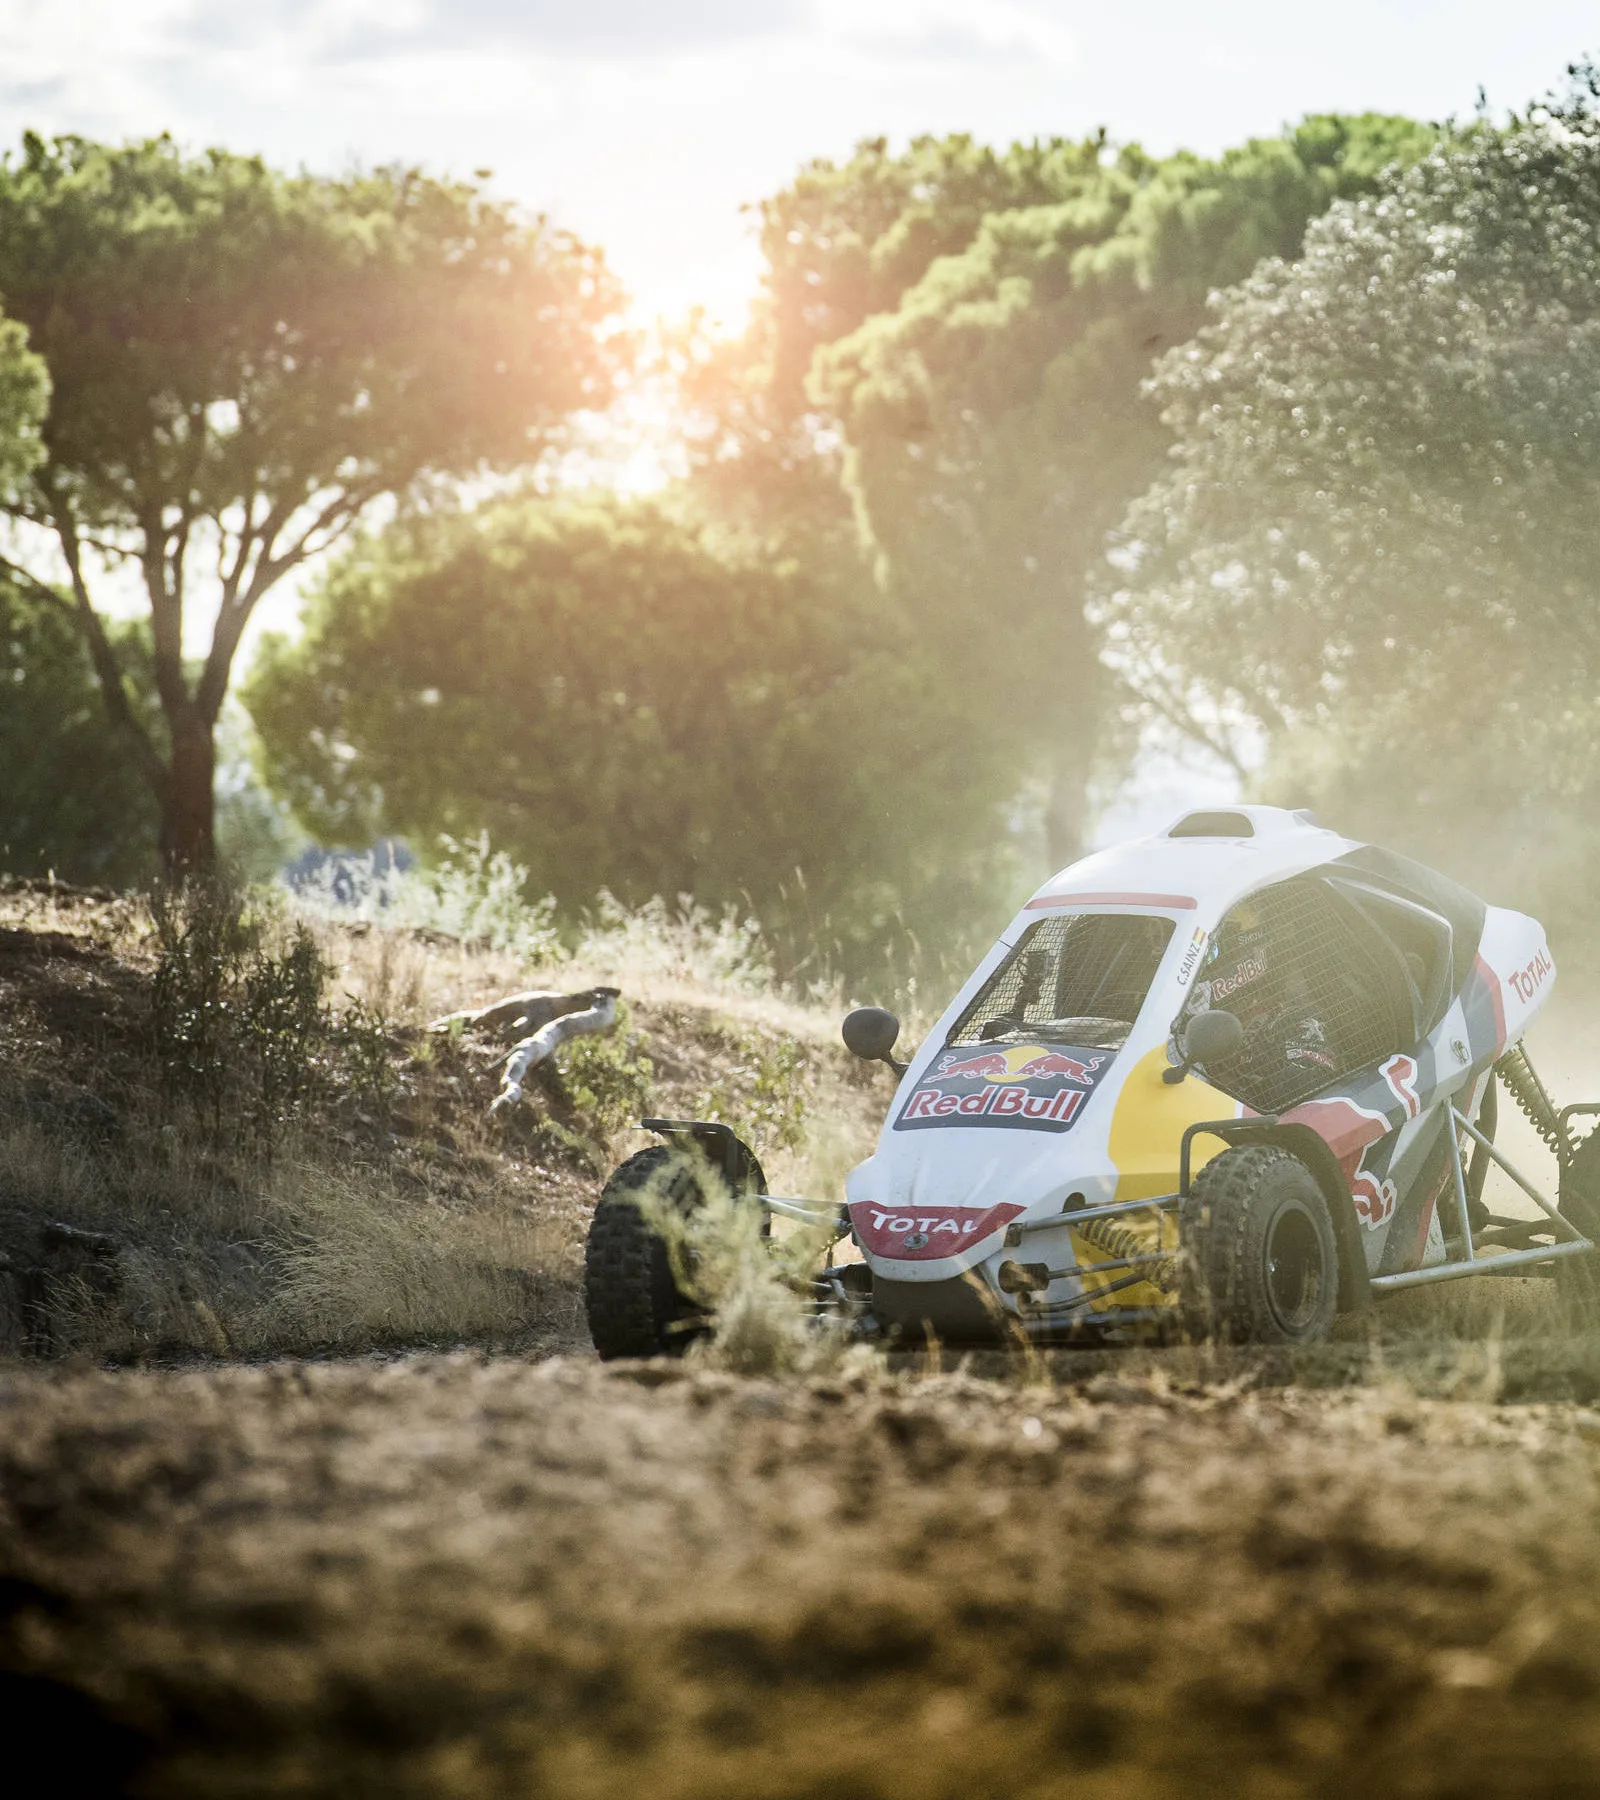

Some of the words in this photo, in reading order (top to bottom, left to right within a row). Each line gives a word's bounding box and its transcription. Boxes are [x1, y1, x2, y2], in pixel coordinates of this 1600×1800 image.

[1211, 962, 1249, 1001] Red
[1508, 948, 1552, 1004] TOTAL
[903, 1085, 998, 1120] Red
[988, 1086, 1086, 1122] Bull
[870, 1209, 978, 1234] TOTAL
